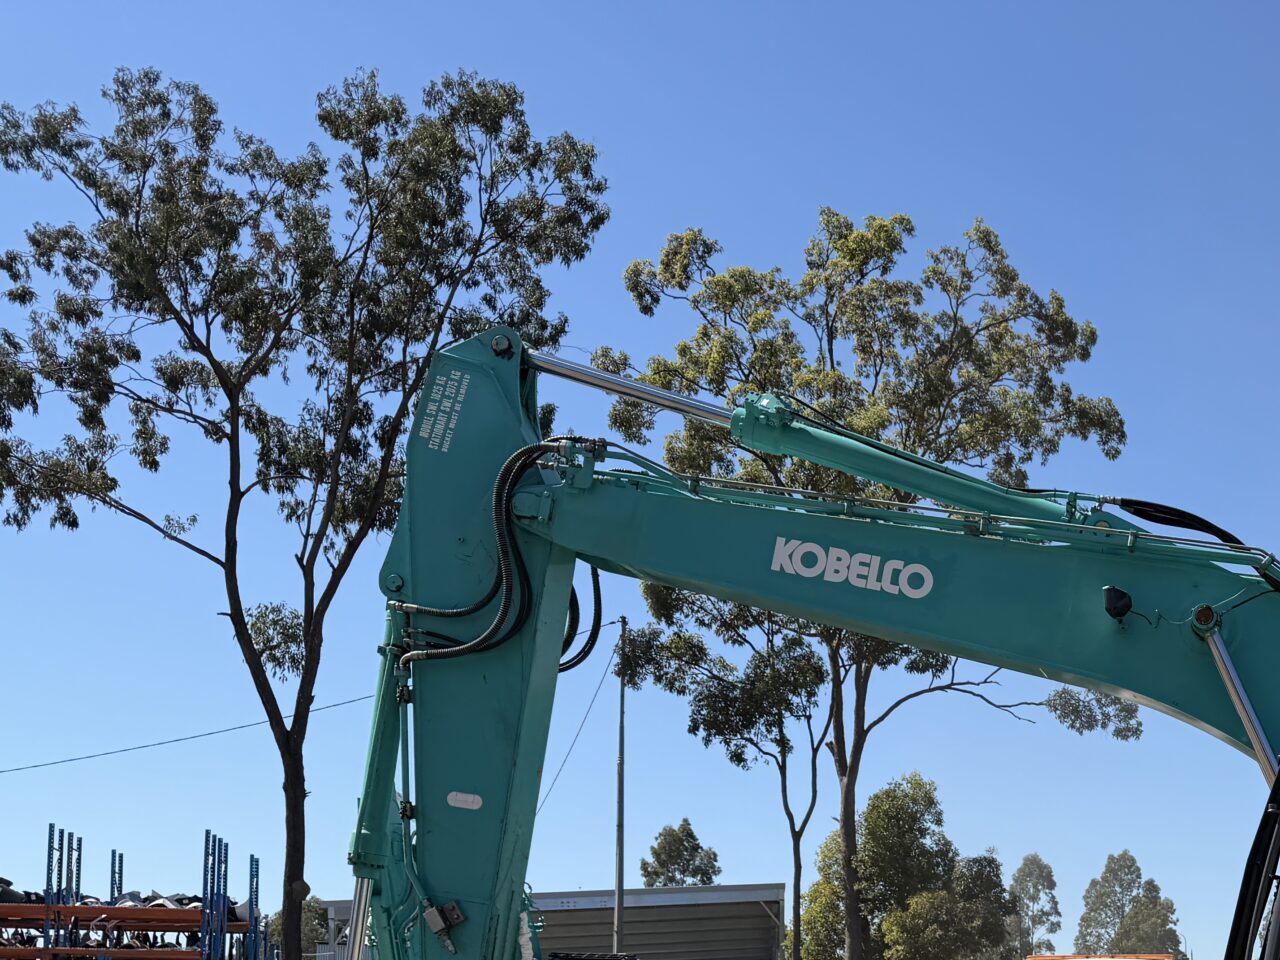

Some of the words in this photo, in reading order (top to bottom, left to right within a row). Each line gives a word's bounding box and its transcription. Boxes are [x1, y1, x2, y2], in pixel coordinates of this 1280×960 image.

[436, 375, 447, 385] KG
[457, 374, 471, 401] REMOVED
[426, 402, 439, 415] SWL
[428, 412, 448, 450] STATIONARY
[440, 398, 453, 412] SWL
[450, 370, 461, 380] KG
[454, 403, 462, 411] BE
[419, 417, 434, 438] MOBILE
[449, 412, 459, 428] MUST
[441, 429, 453, 452] BUCKET
[770, 536, 934, 599] KOBELCO
